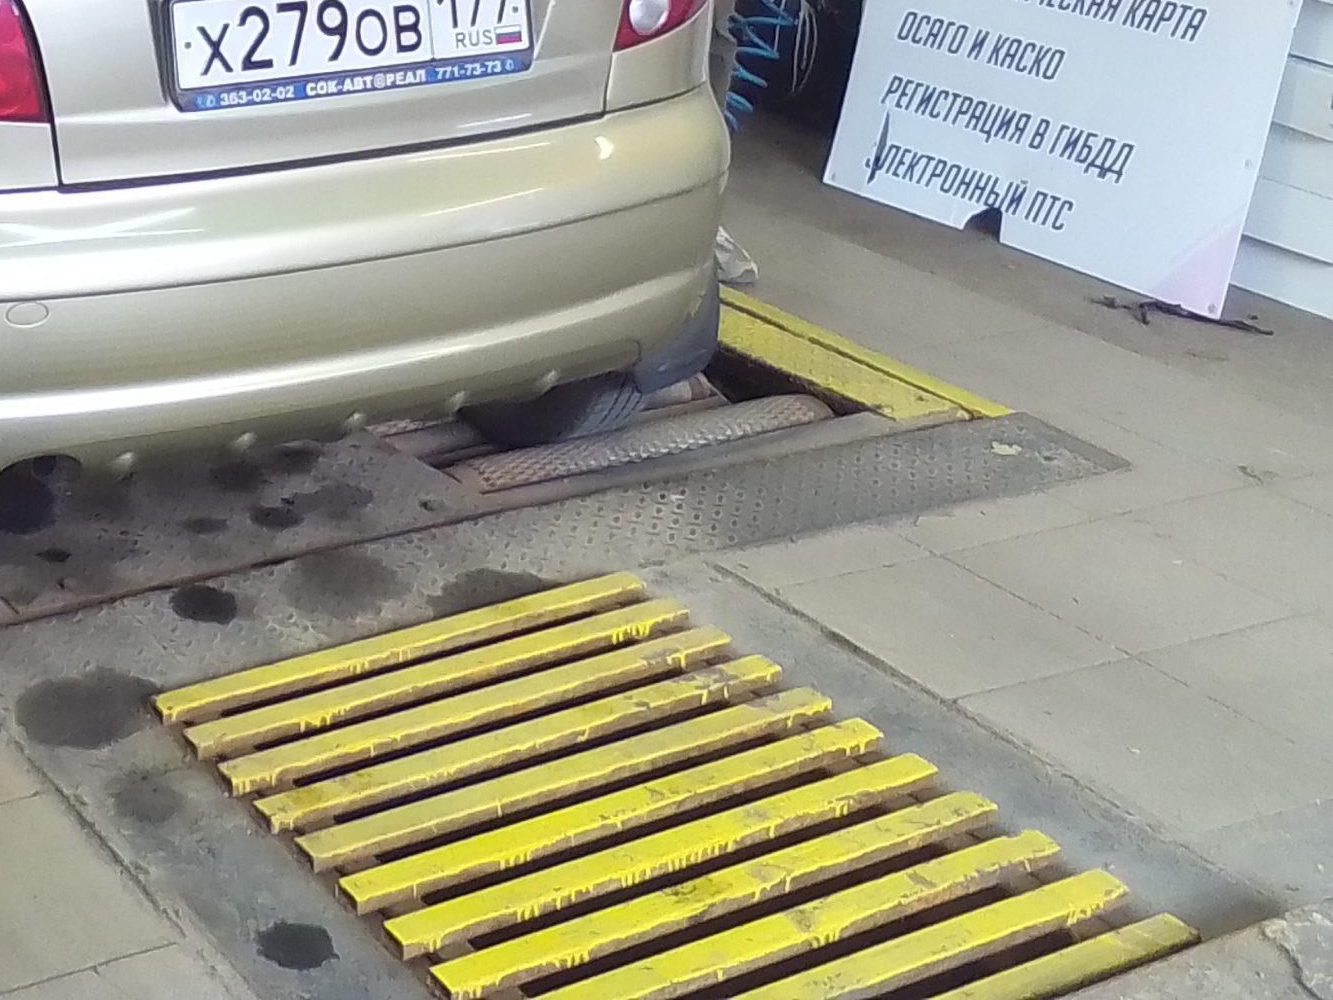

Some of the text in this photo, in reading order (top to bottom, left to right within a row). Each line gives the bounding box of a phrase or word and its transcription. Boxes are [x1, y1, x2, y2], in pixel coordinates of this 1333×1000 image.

[455, 30, 493, 48] RUS
[897, 11, 1066, 80] ОСАГО И КАСКО
[220, 86, 294, 106] 363-02-02
[435, 60, 502, 80] 771-73-73
[881, 75, 1135, 184] РЕГИСТРАЦИЯ В ГИБДД
[1024, 190, 1074, 232] ПТС
